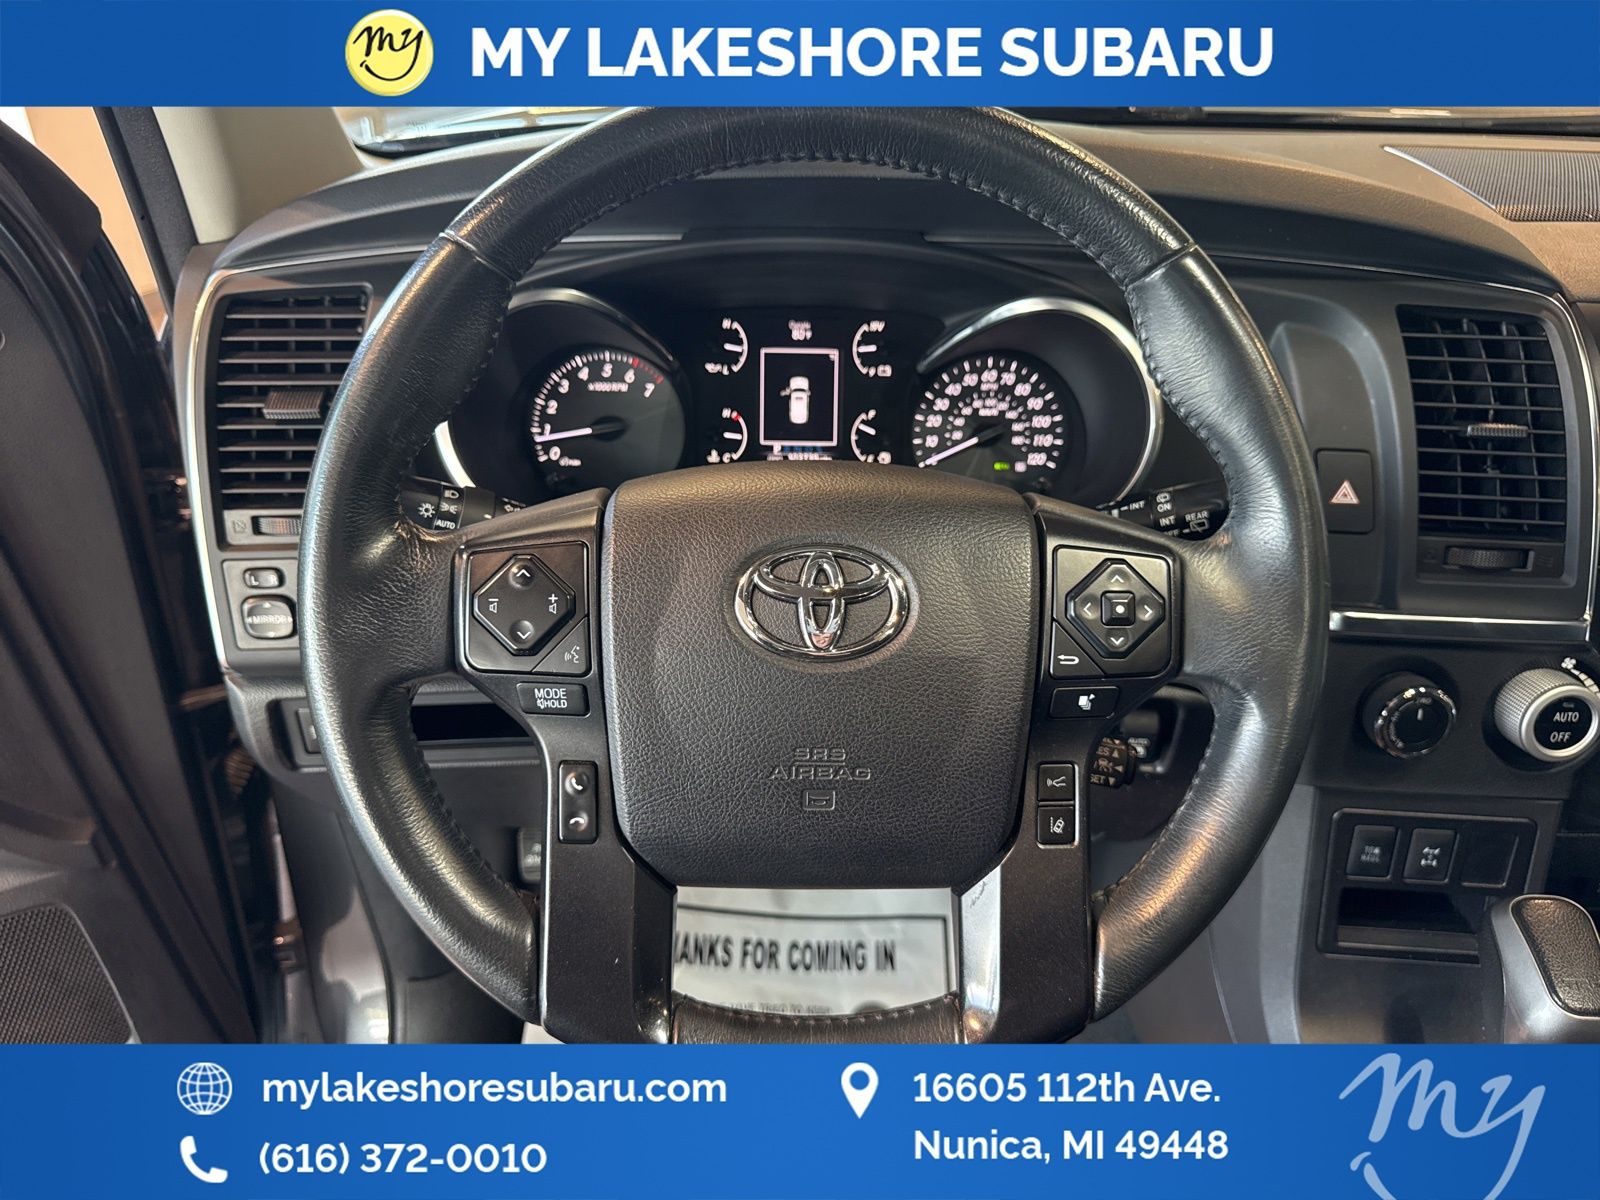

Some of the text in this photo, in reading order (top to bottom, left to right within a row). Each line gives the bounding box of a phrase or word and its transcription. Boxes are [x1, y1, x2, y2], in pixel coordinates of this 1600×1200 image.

[578, 366, 589, 381] 4
[601, 363, 613, 378] 5
[624, 368, 635, 383] 6
[1000, 372, 1016, 386] 70
[558, 379, 570, 394] 3
[644, 383, 655, 398] 7
[945, 383, 962, 396] 40
[546, 400, 558, 414] 2
[933, 398, 950, 411] 30
[1027, 397, 1044, 410] 90
[1032, 415, 1052, 428] 100
[925, 434, 939, 448] 10
[1033, 434, 1053, 447] 110
[550, 446, 561, 461] 0
[1027, 453, 1047, 466] 120
[1129, 500, 1145, 510] INT
[1157, 502, 1172, 513] ON
[1159, 515, 1176, 527] INT
[1185, 511, 1209, 521] REAR
[435, 519, 456, 529] AUTO
[251, 575, 259, 586] L
[253, 615, 288, 624] MIRROR
[534, 688, 567, 699] MODE
[544, 699, 567, 709] HOLD
[1553, 711, 1579, 722] AUTO
[1550, 732, 1572, 743] OFF
[794, 747, 846, 760] SRS
[768, 765, 871, 780] AIRBAG
[675, 931, 897, 971] ANKS FOR COMING IN
